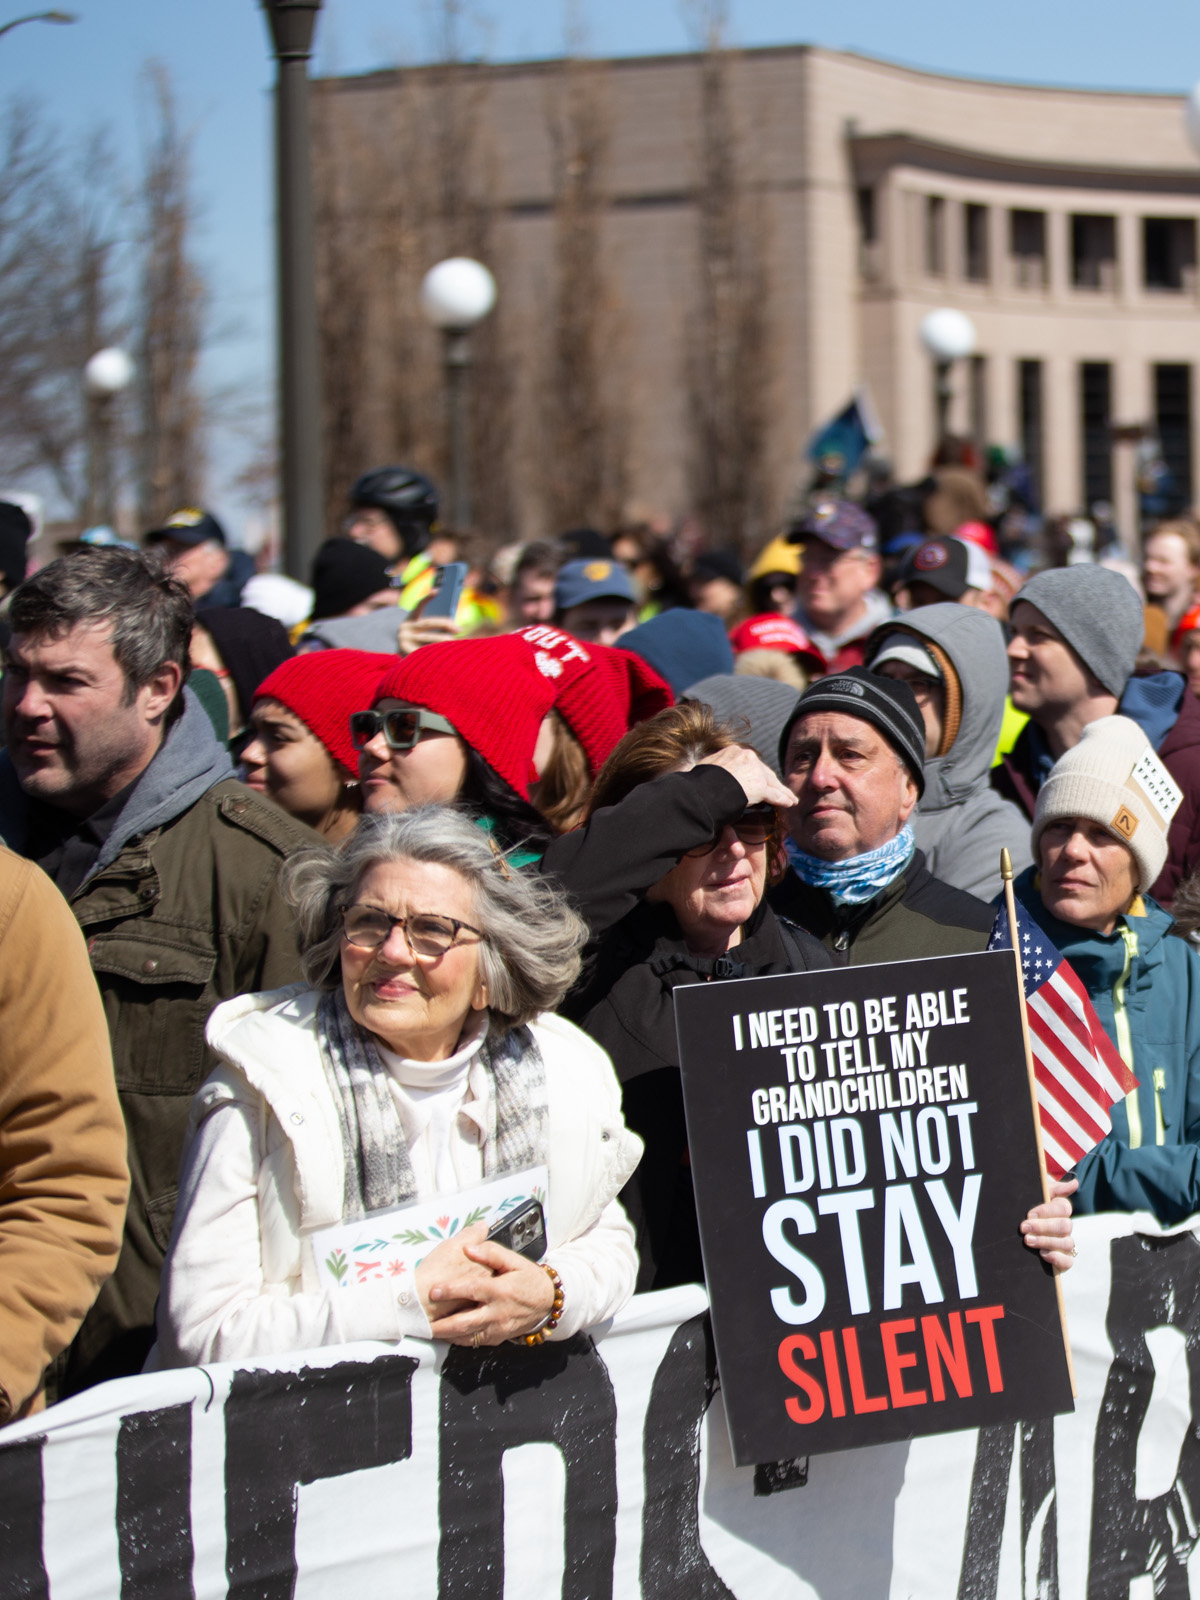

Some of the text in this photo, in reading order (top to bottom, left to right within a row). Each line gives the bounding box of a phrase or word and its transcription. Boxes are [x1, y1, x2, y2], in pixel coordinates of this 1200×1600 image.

[1137, 767, 1170, 812] PEOPLE
[1144, 757, 1177, 805] WE THE
[733, 988, 970, 1050] I NEED TO BE ABLE
[780, 1030, 931, 1083] TO TELL MY
[752, 1064, 969, 1126] GRANDCHILDREN
[746, 1102, 978, 1199] I DID NOT
[762, 1174, 983, 1326] STAY
[777, 1304, 1005, 1425] SILENT
